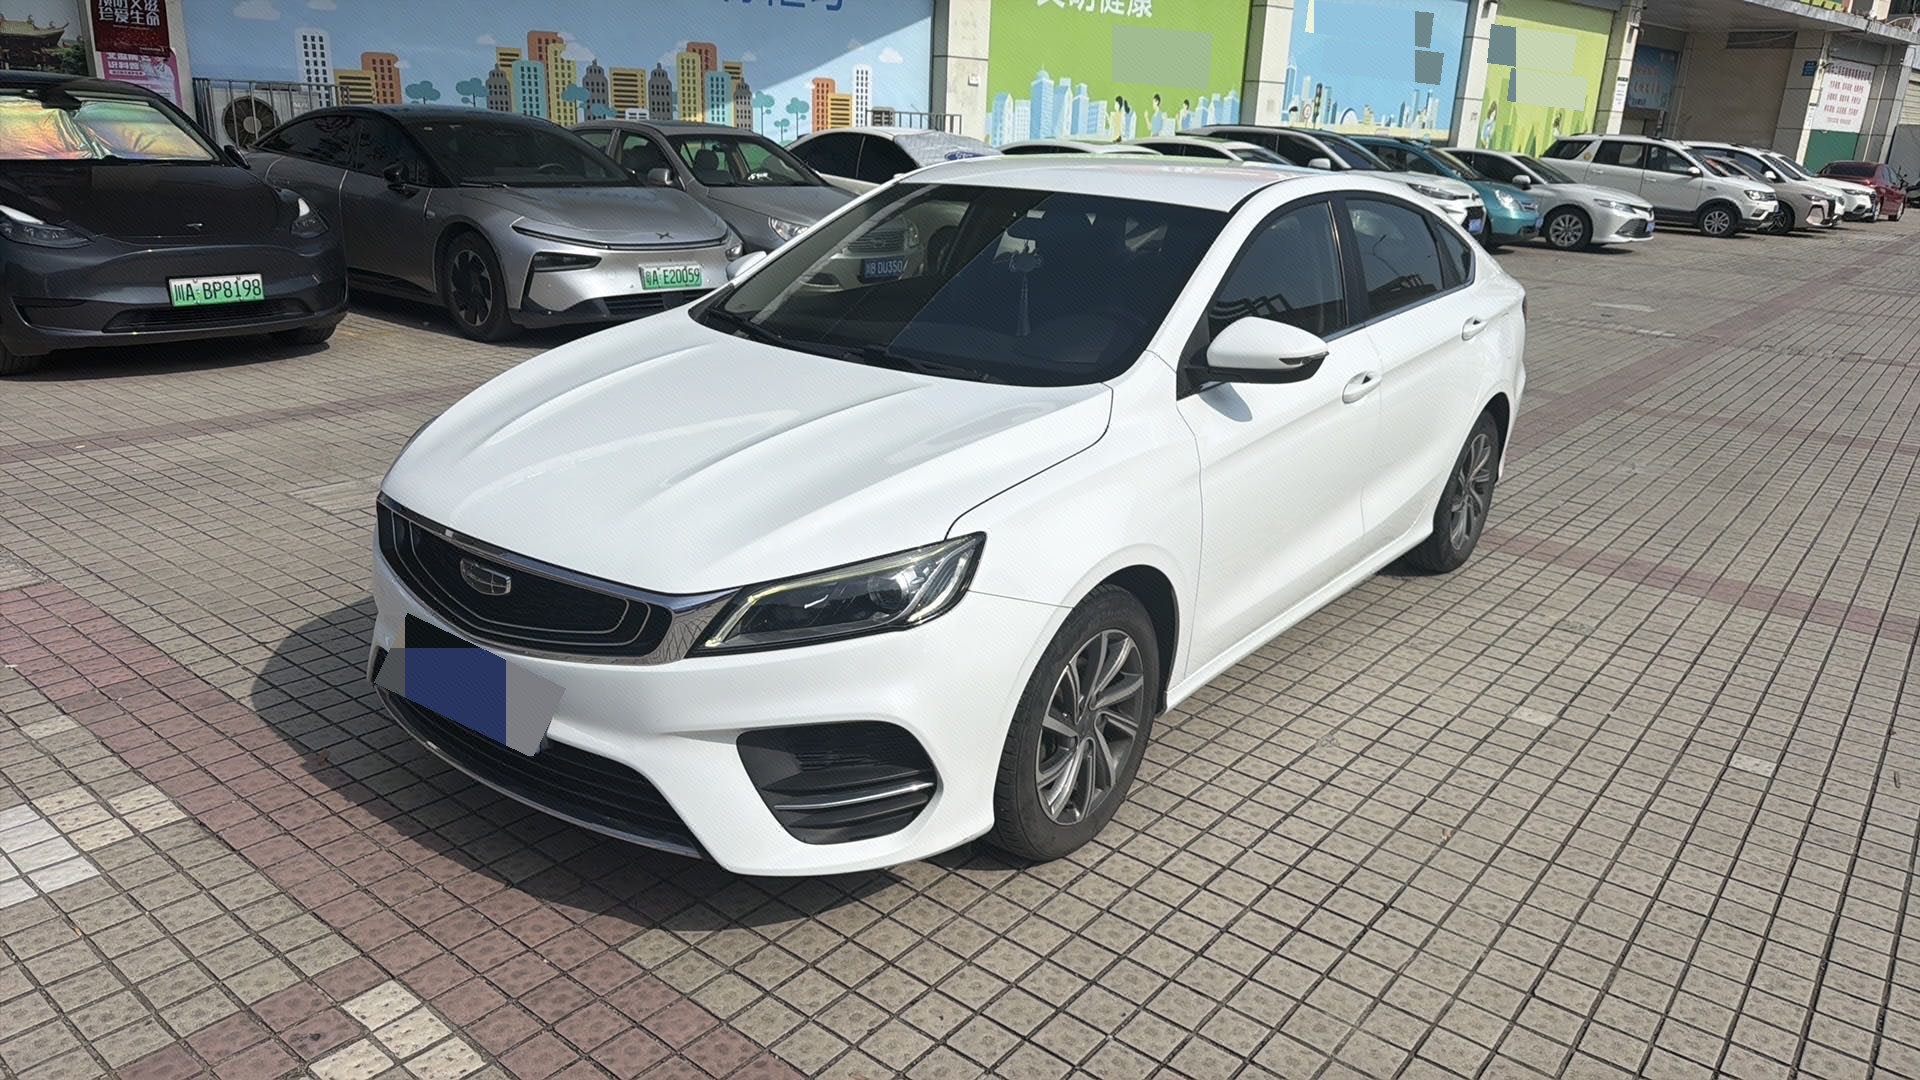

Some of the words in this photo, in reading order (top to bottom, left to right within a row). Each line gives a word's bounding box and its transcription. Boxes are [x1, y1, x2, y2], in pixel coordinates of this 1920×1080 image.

[98, 6, 160, 26] 珍爱生命
[663, 268, 700, 285] E20059
[174, 283, 196, 302] 川A
[202, 279, 262, 300] BP8198
